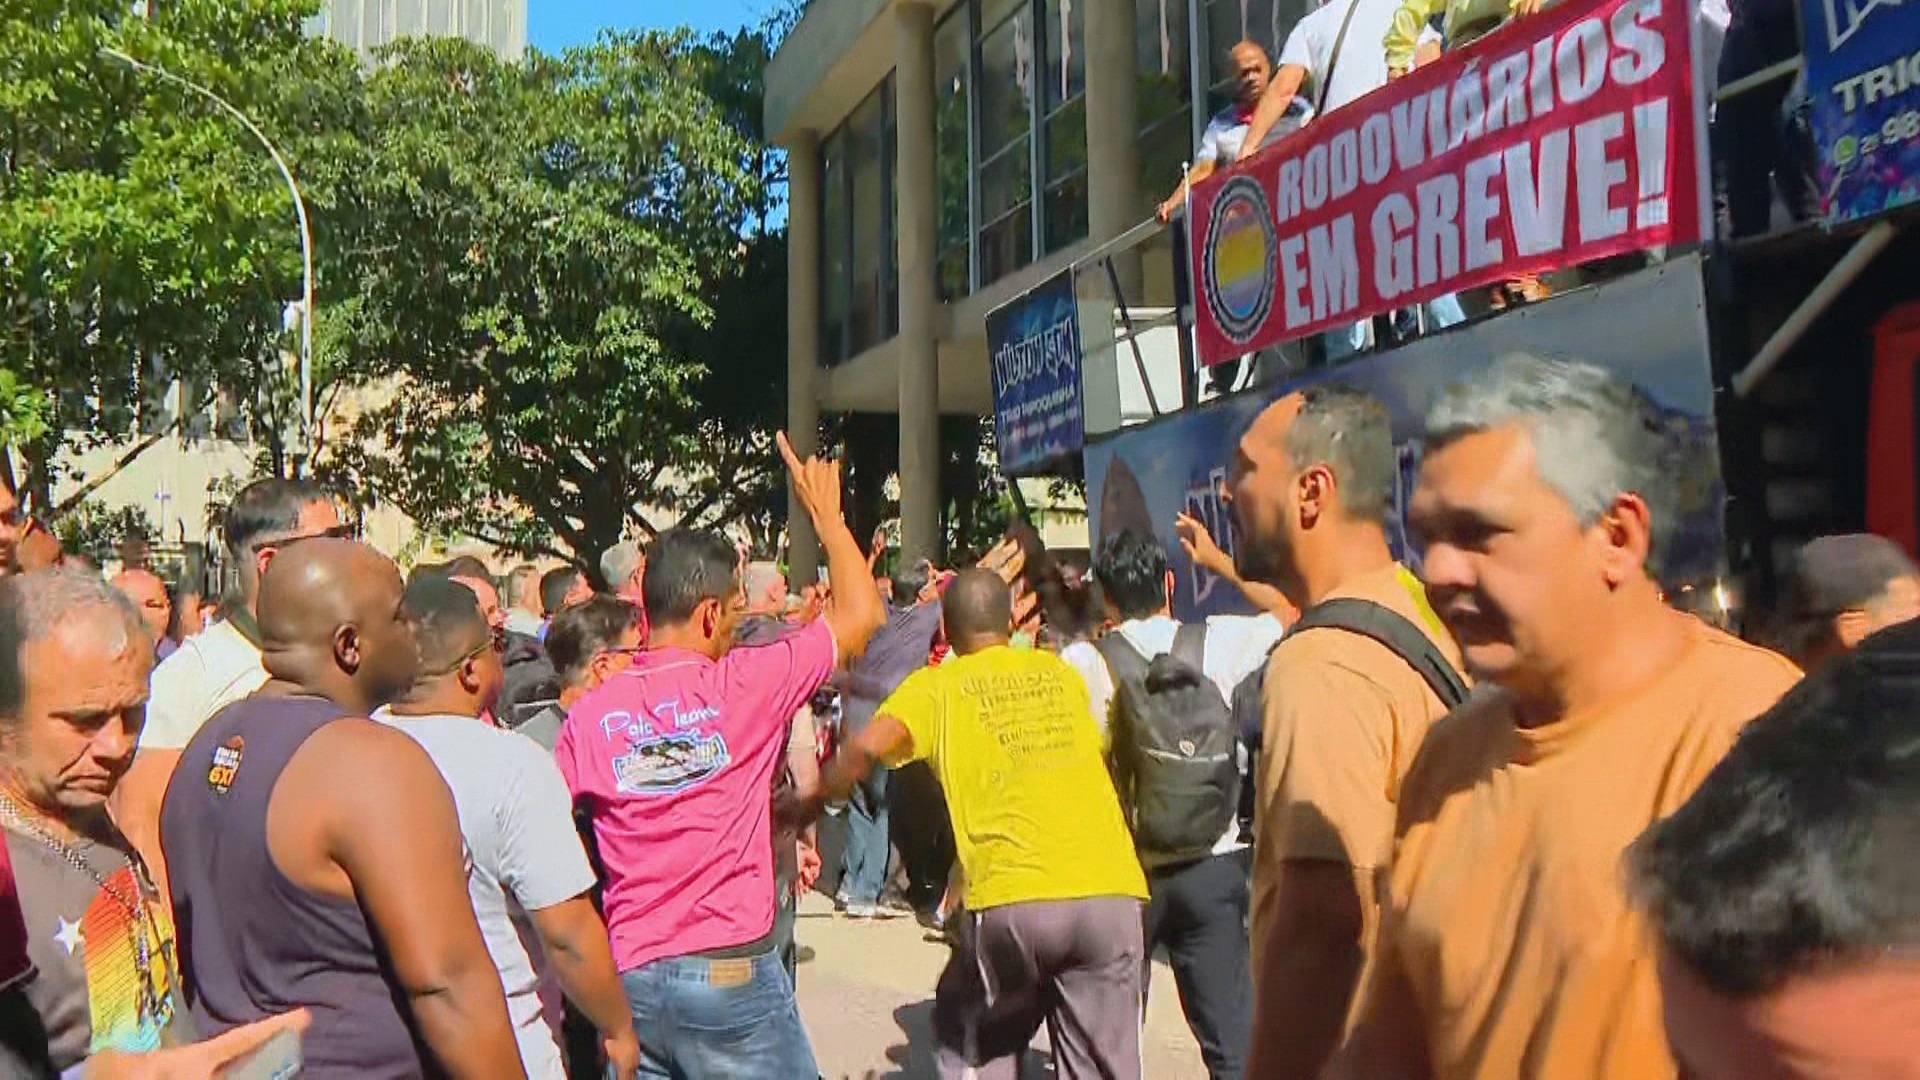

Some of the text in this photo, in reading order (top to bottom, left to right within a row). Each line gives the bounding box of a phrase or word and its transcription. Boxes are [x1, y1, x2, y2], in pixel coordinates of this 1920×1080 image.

[1278, 0, 1666, 223] RODOVIÁRIOS
[1280, 97, 1668, 330] EM GREVE!
[654, 699, 720, 728] Team
